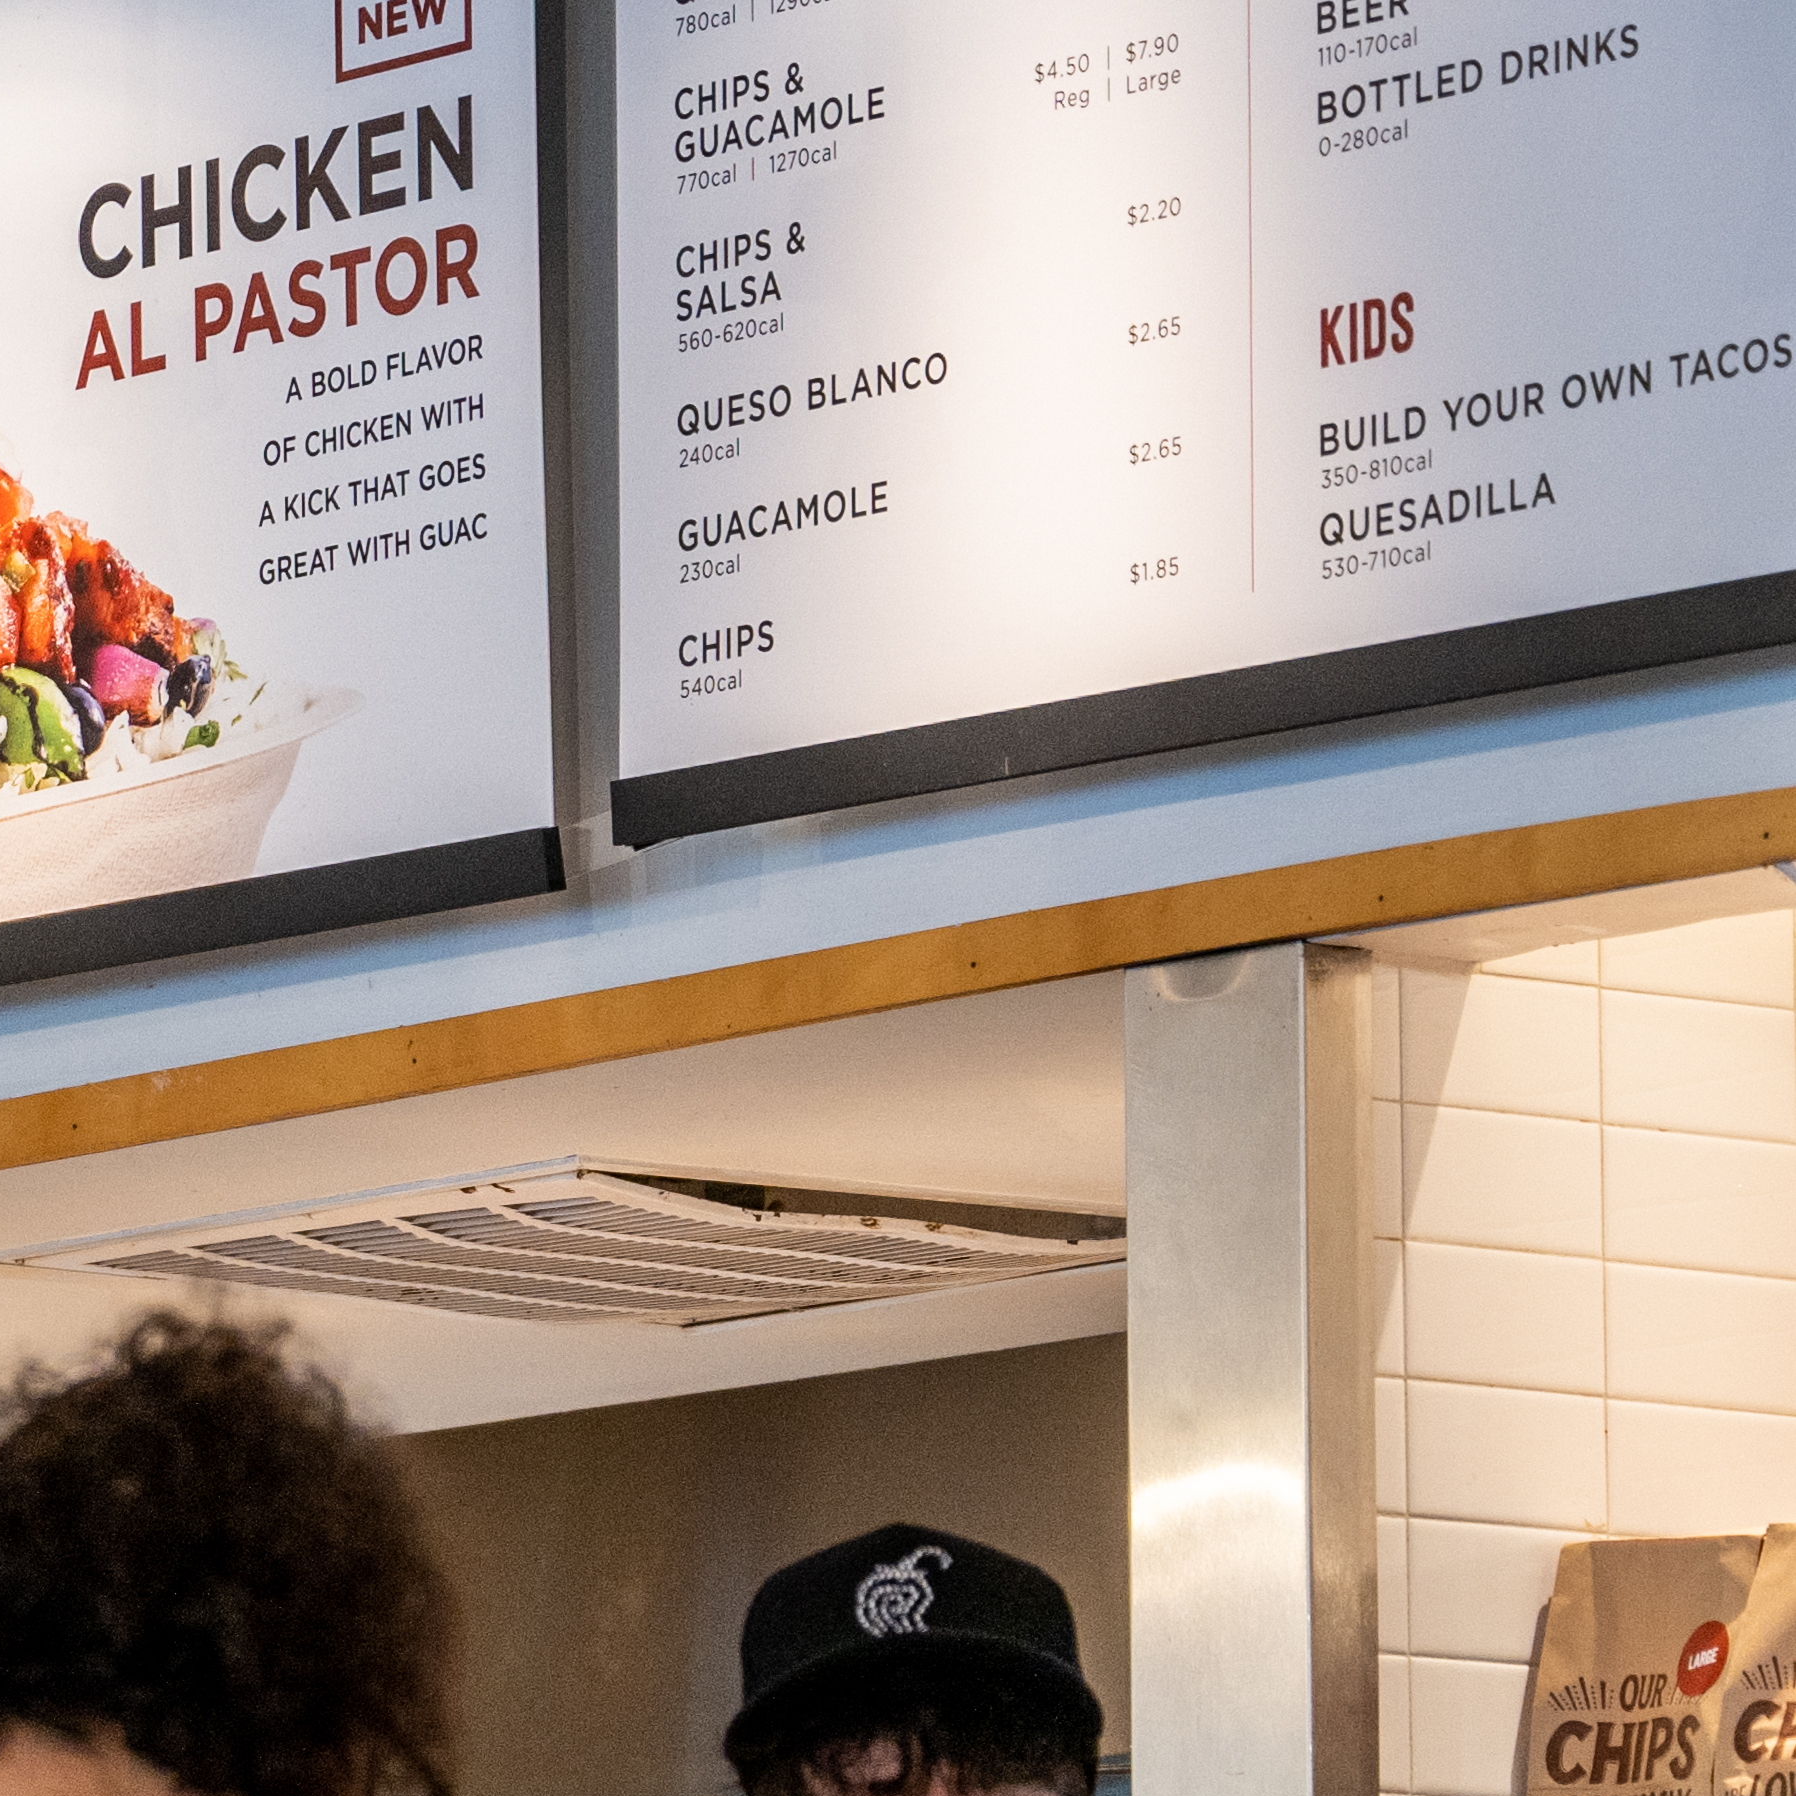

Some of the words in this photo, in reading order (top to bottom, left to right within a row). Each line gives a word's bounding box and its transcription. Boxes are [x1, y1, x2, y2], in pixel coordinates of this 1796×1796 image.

[358, 0, 446, 45] NEW
[676, 4, 736, 37] 780cal
[1317, 0, 1409, 35] BEER
[1035, 53, 1089, 84] $4.50
[1126, 33, 1179, 63] $7.90
[1318, 27, 1417, 66] 110-170cal
[675, 70, 769, 120] CHIPS
[785, 63, 803, 95] &
[1054, 89, 1090, 109] Reg
[1126, 69, 1181, 95] Large
[1318, 59, 1483, 125] BOTTLED
[1501, 24, 1638, 85] DRINKS
[675, 86, 885, 163] GUACAMOLE
[1319, 119, 1408, 157] 0-280cal
[78, 95, 473, 279] CHICKEN
[677, 163, 736, 194] 770cal
[769, 141, 836, 173] 1270cal
[1127, 197, 1181, 226] $2.20
[676, 229, 771, 278] CHIPS
[786, 222, 805, 254] &
[76, 300, 166, 390] AL
[194, 222, 480, 362] PASTOR
[676, 270, 782, 322] SALSA
[679, 313, 784, 353] 560-620cal
[1128, 316, 1181, 345] $2.65
[1320, 292, 1414, 368] KIDS
[286, 378, 302, 404] A
[312, 359, 377, 398] BOLD
[386, 334, 483, 380] FLAVOR
[677, 385, 791, 436] QUESO
[808, 352, 947, 410] BLANCO
[1320, 406, 1426, 460] BUILD
[1443, 382, 1544, 431] YOUR
[1562, 361, 1651, 409] OWN
[1669, 333, 1792, 387] TACOS
[263, 436, 296, 466] OF
[305, 410, 411, 457] CHICKEN
[421, 394, 483, 431] WITH
[679, 438, 740, 468] 240cal
[1129, 436, 1181, 465] $2.65
[259, 501, 275, 527] A
[284, 485, 340, 521] KICK
[348, 470, 410, 506] THAT
[419, 453, 486, 491] GOES
[1322, 449, 1432, 489] 350-810cal
[678, 481, 888, 551] GUACAMOLE
[1320, 472, 1556, 547] QUESADILLA
[259, 545, 338, 585] GREAT
[347, 530, 410, 566] WITH
[420, 513, 487, 551] GUAC
[680, 554, 740, 584] 230cal
[1130, 556, 1179, 584] $1.85
[1322, 541, 1431, 580] 530-710cal
[679, 620, 774, 667] CHIPS
[681, 669, 742, 699] 540cal
[1688, 1647, 1719, 1671] LARGE
[1619, 1674, 1668, 1712] OUR
[1545, 1714, 1701, 1785] CHIPS
